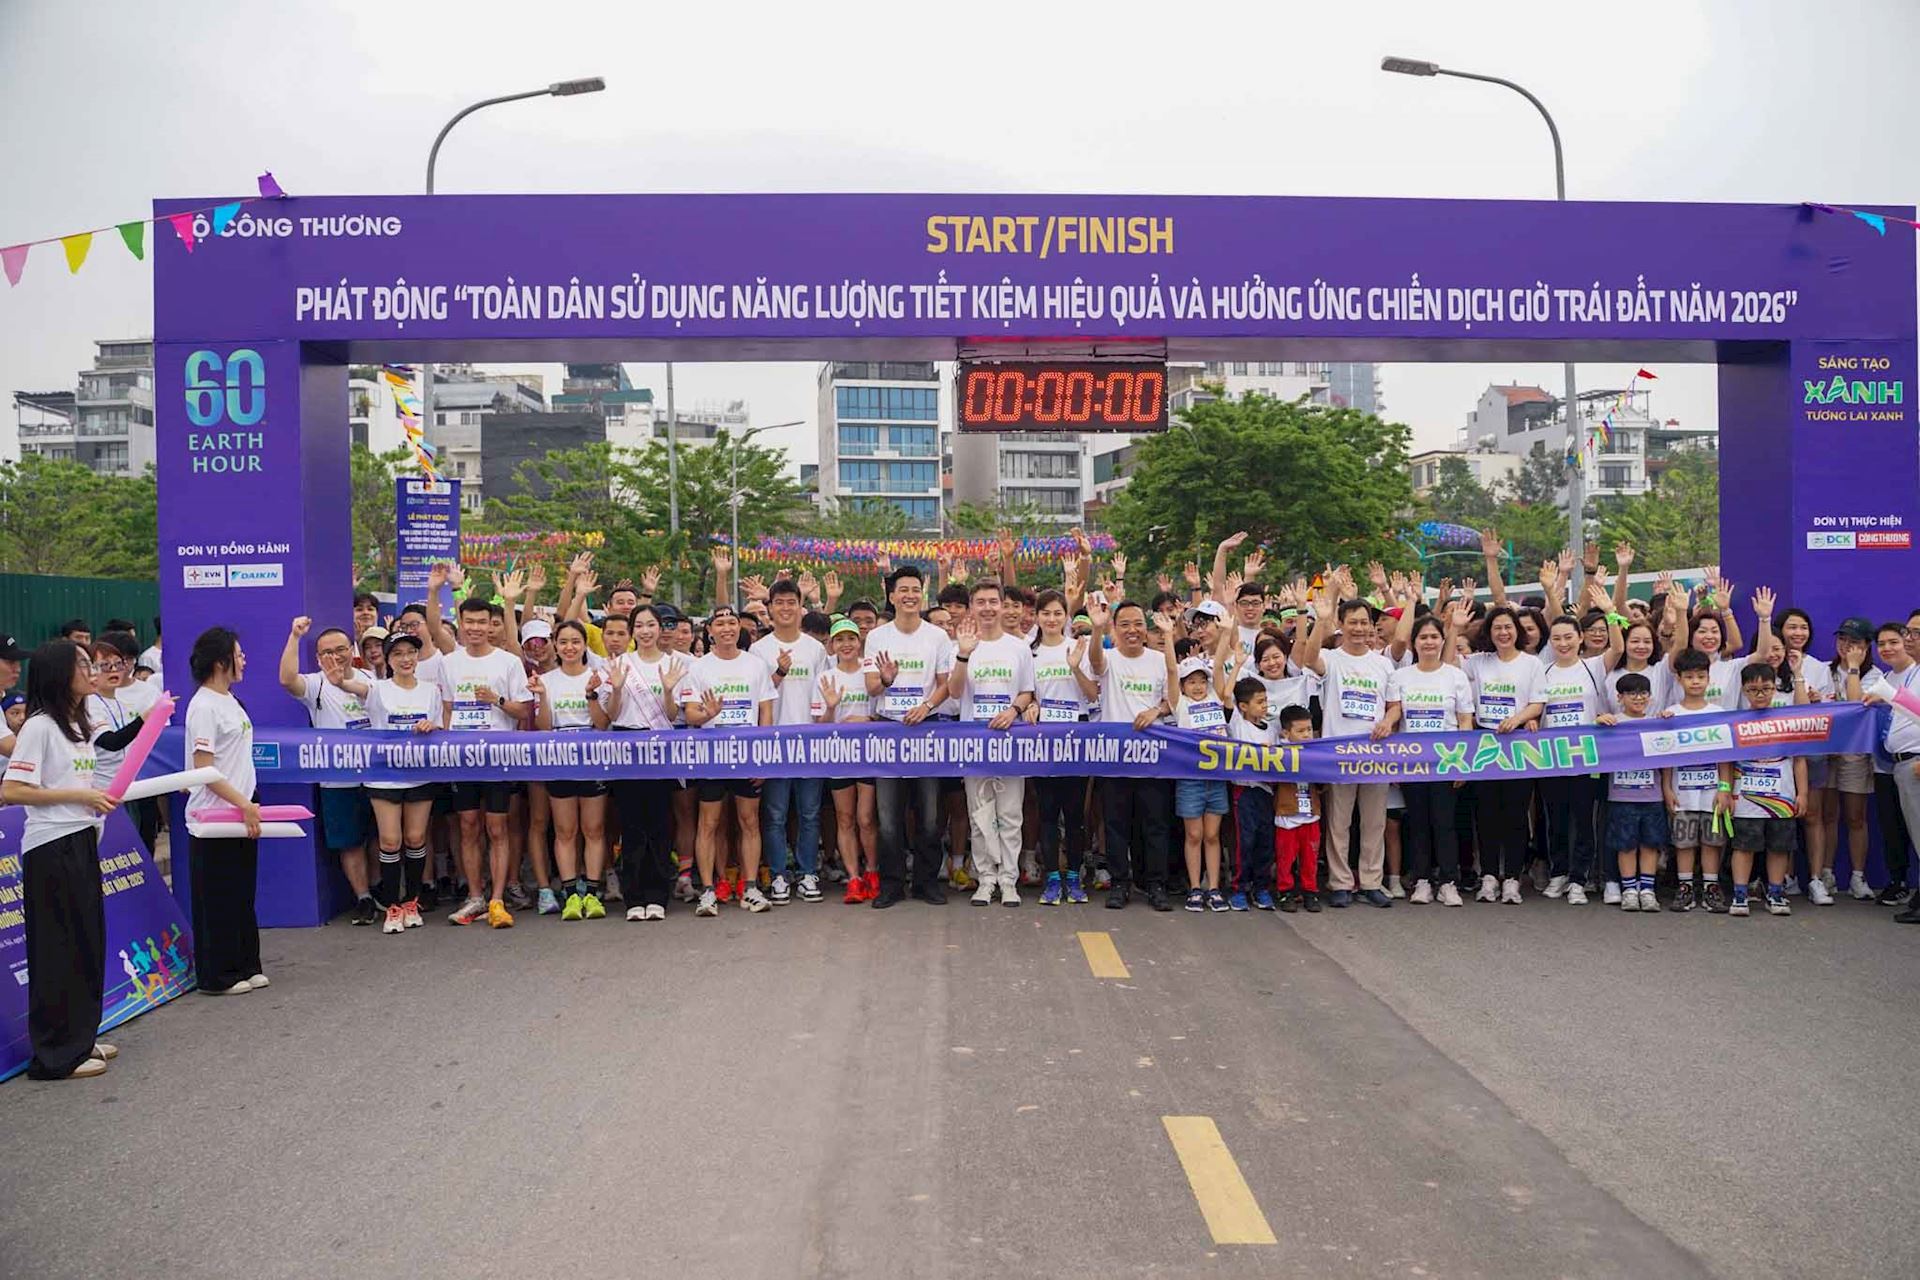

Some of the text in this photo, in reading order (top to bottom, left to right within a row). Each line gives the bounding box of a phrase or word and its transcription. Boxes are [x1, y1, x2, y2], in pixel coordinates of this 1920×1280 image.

[176, 213, 402, 243] Ộ CÔNG THƯƠNG
[926, 215, 1174, 259] START/FINISH
[297, 278, 368, 321] PHÁT
[373, 278, 447, 329] ĐỘNG
[548, 277, 604, 319] DÂN
[611, 273, 646, 319] SỬ
[652, 284, 725, 328] DỤNG
[732, 276, 808, 319] NĂNG
[815, 279, 905, 328] LƯỢNG
[910, 269, 967, 319] TIẾT
[973, 276, 1037, 328] KIỆM
[1044, 276, 1103, 328] HIỆU
[1111, 274, 1166, 327] QUẢ
[1170, 277, 1207, 319] VÀ
[1213, 274, 1302, 320] HƯỞNG
[1309, 279, 1362, 321] ỨNG
[1368, 272, 1442, 321] CHIẾN
[1448, 288, 1503, 330] DỊCH
[1510, 280, 1550, 321] GIỜ
[1554, 282, 1611, 322] TRÁI
[1617, 274, 1666, 322] ĐẤT
[1671, 282, 1726, 323] NĂM
[1818, 355, 1890, 372] SÁNG TẠO
[185, 349, 266, 426] 60
[965, 371, 1163, 422] 00:00:00
[1806, 410, 1904, 421] TƯƠNG LAI XANH
[188, 432, 263, 451] EARTH
[193, 455, 263, 473] HOUR
[1813, 514, 1902, 528] ĐƠN VỊ THỰC HIỆN
[1826, 535, 1851, 544] ĐCK
[177, 540, 290, 558] ĐƠN VỊ ĐỒNG HÀNH
[240, 571, 278, 580] DAIKIN
[891, 697, 918, 707] 3.663
[976, 702, 1009, 714] 28.719
[1343, 700, 1375, 712] 28.403
[458, 711, 486, 720] 3.443
[720, 710, 748, 720] 3.259
[1046, 709, 1074, 720] 3.333
[1193, 710, 1223, 723] 28.705
[1485, 705, 1510, 716] 3.668
[1409, 720, 1442, 729] 28.402
[1552, 713, 1580, 724] 3.624
[1677, 726, 1722, 744] ĐCK
[299, 736, 329, 769] GIẢI
[333, 743, 373, 774] CHẠY
[429, 741, 461, 767] DÂN
[465, 739, 488, 767] SỬ
[490, 743, 531, 772] DỤNG
[535, 739, 579, 766] NĂNG
[582, 740, 633, 771] LƯỢNG
[636, 735, 667, 765] TIẾT
[671, 736, 709, 770] KIỆM
[713, 735, 748, 770] HIỆU
[752, 731, 782, 766] QUẢ
[786, 734, 806, 764] VÀ
[810, 731, 861, 763] HƯỞNG
[865, 733, 896, 763] ỨNG
[900, 731, 945, 763] CHIẾN
[949, 738, 984, 768] DỊCH
[988, 731, 1013, 762] GIỜ
[1017, 732, 1049, 762] TRÁI
[1053, 730, 1082, 762] ĐẤT
[1085, 733, 1119, 762] NĂM
[1198, 739, 1304, 773] START
[1335, 742, 1422, 758] SÁNG TẠO
[1338, 760, 1429, 775] TƯƠNG LAI
[1616, 770, 1651, 780] 21.745
[1681, 771, 1716, 781] 21.560
[1743, 777, 1777, 787] 21.657
